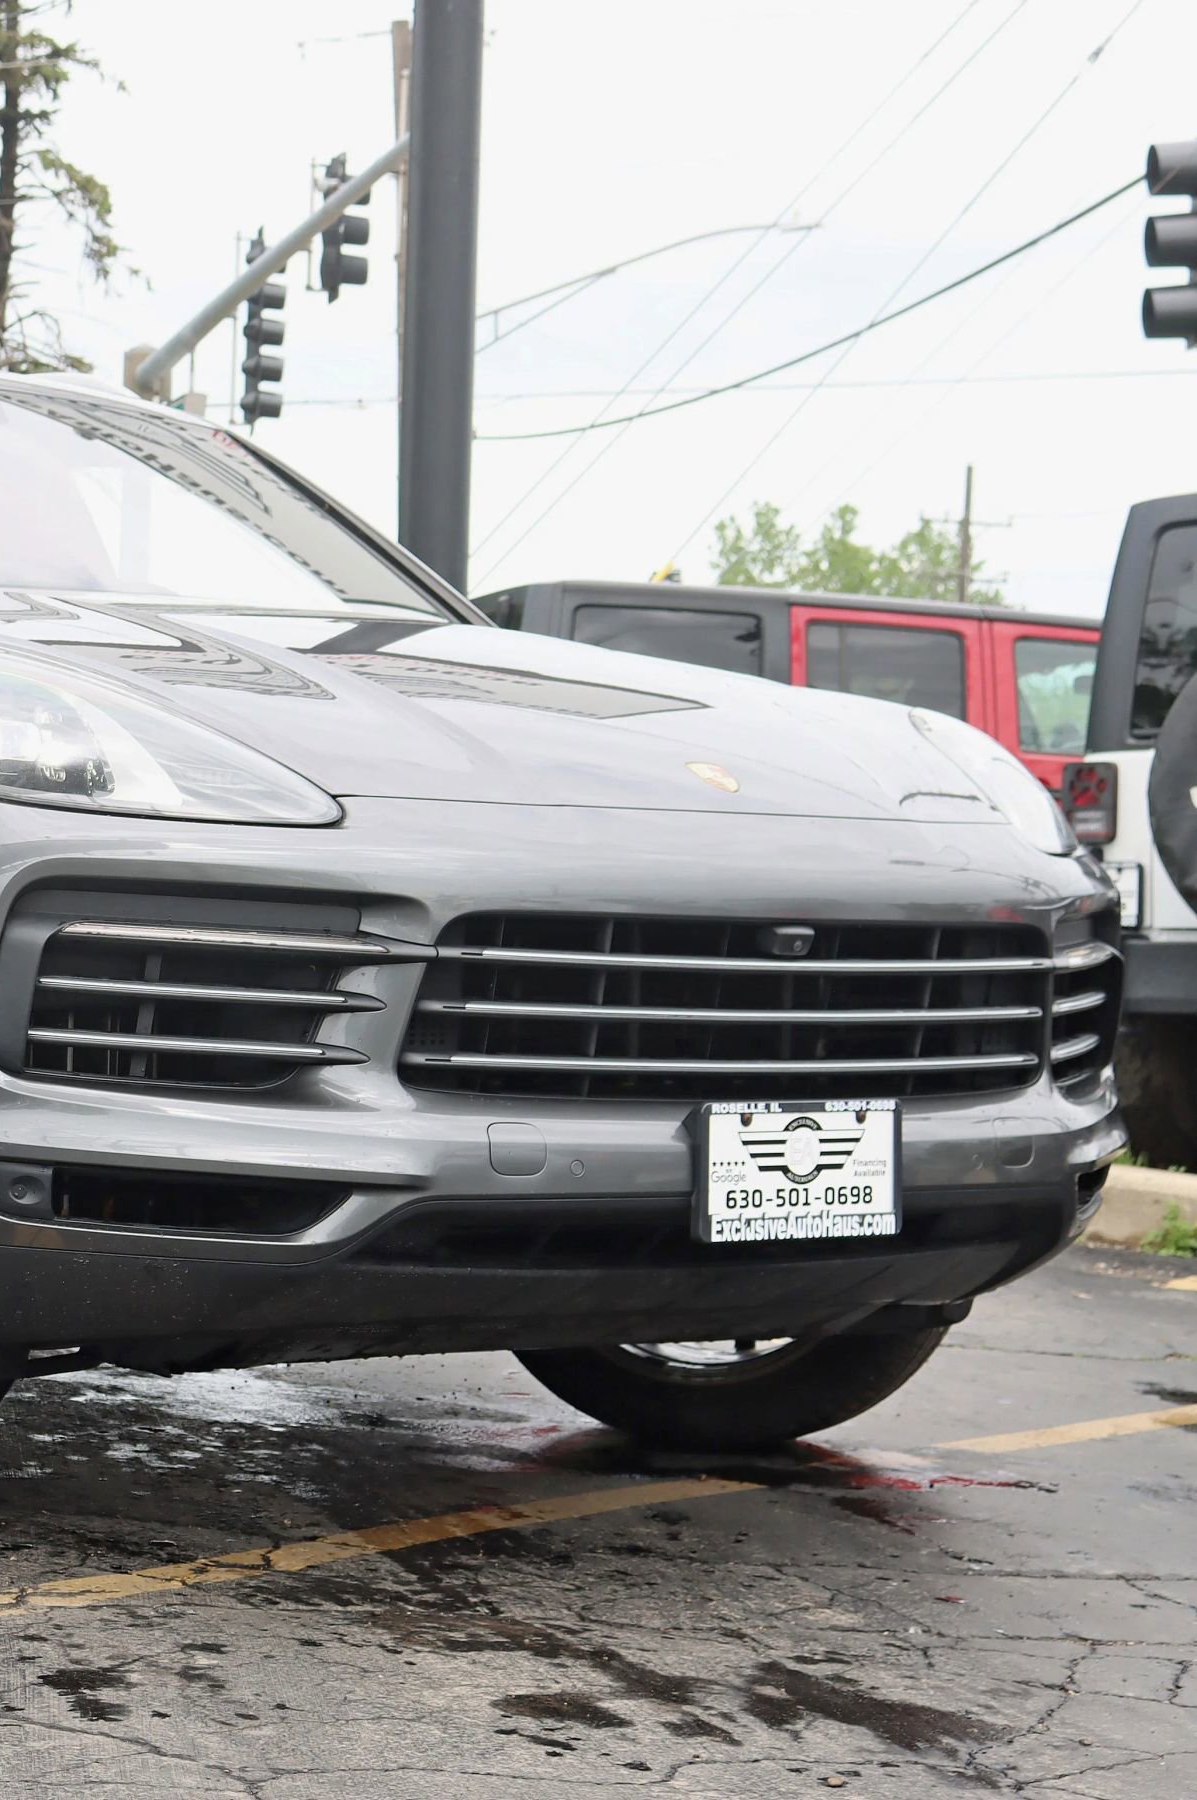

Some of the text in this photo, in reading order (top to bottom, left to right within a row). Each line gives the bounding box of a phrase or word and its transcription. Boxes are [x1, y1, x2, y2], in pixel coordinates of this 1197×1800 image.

[770, 1102, 783, 1112] IL
[711, 1170, 747, 1186] Google
[726, 1186, 873, 1209] 630-501-0698
[711, 1211, 897, 1242] ExclusiveAutoHaus.com
